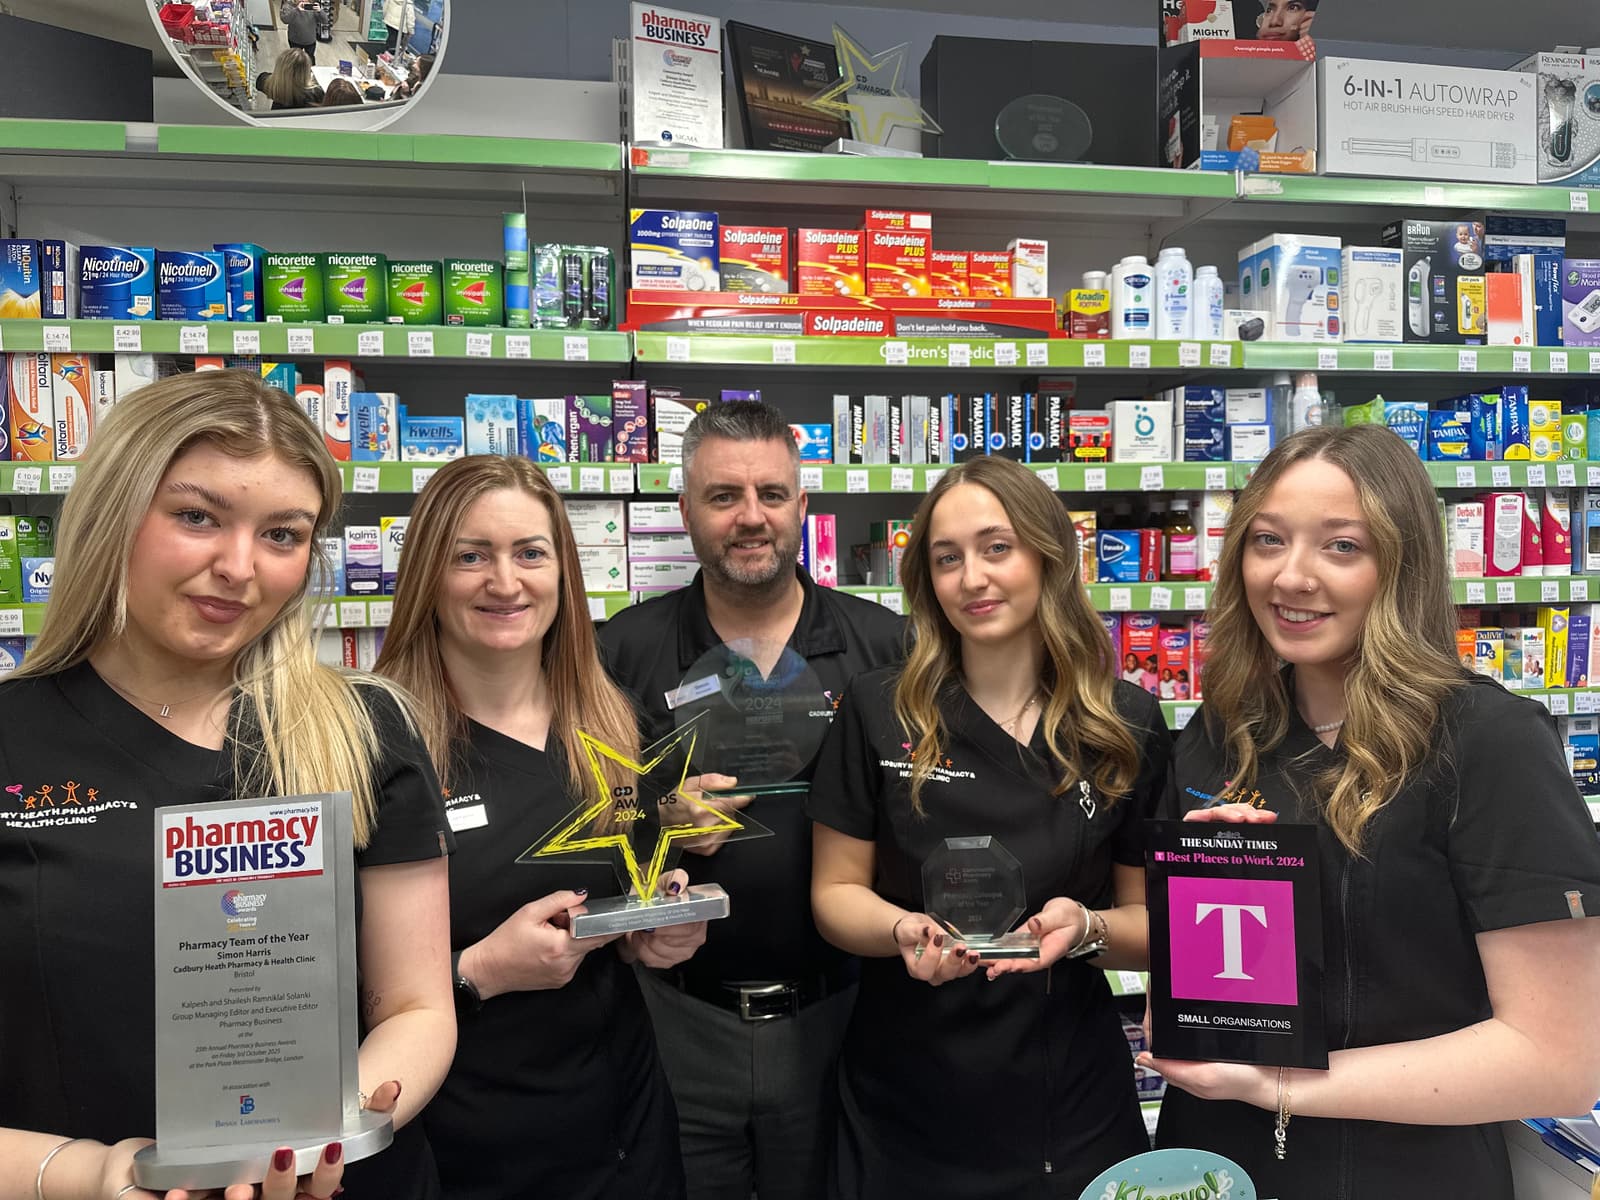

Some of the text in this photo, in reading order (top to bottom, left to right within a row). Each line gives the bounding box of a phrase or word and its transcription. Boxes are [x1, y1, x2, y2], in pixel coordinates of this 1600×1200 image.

[642, 10, 711, 38] pharmacy
[646, 24, 706, 46] BUSINESS
[1192, 28, 1230, 37] MIGHTY
[1541, 55, 1580, 65] REMINGTON
[856, 82, 891, 96] AWARDS
[1344, 75, 1518, 108] 6-IN-1 AUTOWRAP
[1344, 101, 1514, 121] HOT AIR BRUSH HIGH SPEED HAIR DRYER
[661, 216, 714, 232] SolpaOne
[724, 230, 782, 244] Solpadeine
[805, 232, 858, 246] Solpadeine
[874, 234, 926, 248] Solpadeine
[836, 244, 858, 254] PLUS
[904, 248, 926, 256] PLUS
[82, 256, 140, 272] Nicotinell
[230, 256, 248, 268] tinell
[268, 254, 316, 266] nicorette
[328, 254, 377, 266] nicorette
[931, 252, 968, 262] Solpadeine
[973, 253, 1010, 263] Solpadeine
[160, 262, 212, 277] Nicotinell
[392, 263, 433, 273] nicorette
[450, 261, 494, 272] nicorette
[1552, 262, 1560, 294] Flowflex
[738, 294, 798, 306] Solpadeine PLUS
[938, 298, 976, 309] Solpadeine
[1076, 292, 1106, 302] Anadin
[705, 320, 730, 328] REGULAR
[731, 320, 745, 328] PAIN
[746, 321, 764, 329] RELIEF
[764, 321, 780, 329] ISN'T
[813, 315, 884, 334] Solpadeine
[896, 323, 988, 334] Don't let pain hold you back.
[880, 344, 947, 359] Cdren's
[38, 352, 50, 389] oltarol
[613, 382, 646, 391] Phenergan
[1508, 394, 1519, 435] TAMPAX
[357, 406, 370, 450] Kwells
[973, 397, 984, 448] PARAMOL
[1011, 396, 1022, 448] PARAMOL
[1050, 396, 1060, 448] PARAMOL
[408, 426, 454, 438] Kwells
[568, 410, 578, 463] Phenergan
[854, 404, 862, 456] MIGRALEVE
[890, 406, 900, 456] MIGRALEVE
[930, 406, 940, 456] MIGRALEVE
[1432, 428, 1467, 438] TAMPAX
[57, 420, 68, 456] Voltarol
[1456, 506, 1482, 518] Derbac M
[350, 530, 378, 544] kalms
[1129, 616, 1152, 626] Calpol
[1162, 637, 1184, 648] Calpol
[744, 696, 782, 711] 2024
[879, 760, 908, 770] ADBURY
[614, 793, 678, 810] AWDS
[20, 800, 138, 820] HEATH PHARMACY &
[614, 808, 646, 822] 2024
[6, 815, 97, 829] HEALTH CLINIC
[166, 814, 318, 859] pharmacy
[1180, 838, 1278, 850] THE SUNDAY TIMES
[174, 840, 306, 878] BUSINESS
[1166, 851, 1305, 868] Best Places to Work 2024
[233, 893, 267, 902] pharmacy
[179, 932, 310, 951] Pharmacy Team of the Year
[1196, 902, 1268, 980] T
[217, 948, 272, 960] Simon Harris
[173, 963, 204, 974] Cadbury
[204, 962, 226, 972] Heath
[228, 959, 263, 970] Pharmacy
[270, 956, 295, 966] Health
[296, 954, 316, 964] Clinic
[234, 970, 256, 978] Bristol
[181, 992, 311, 1010] Kalpesh and Shailesh Ramniklal Solanki
[172, 1002, 318, 1022] Group Managing Editor and Executive Editor
[218, 1016, 282, 1029] Pharmacy Business
[1177, 1014, 1292, 1030] SMALL ORGANISATIONS
